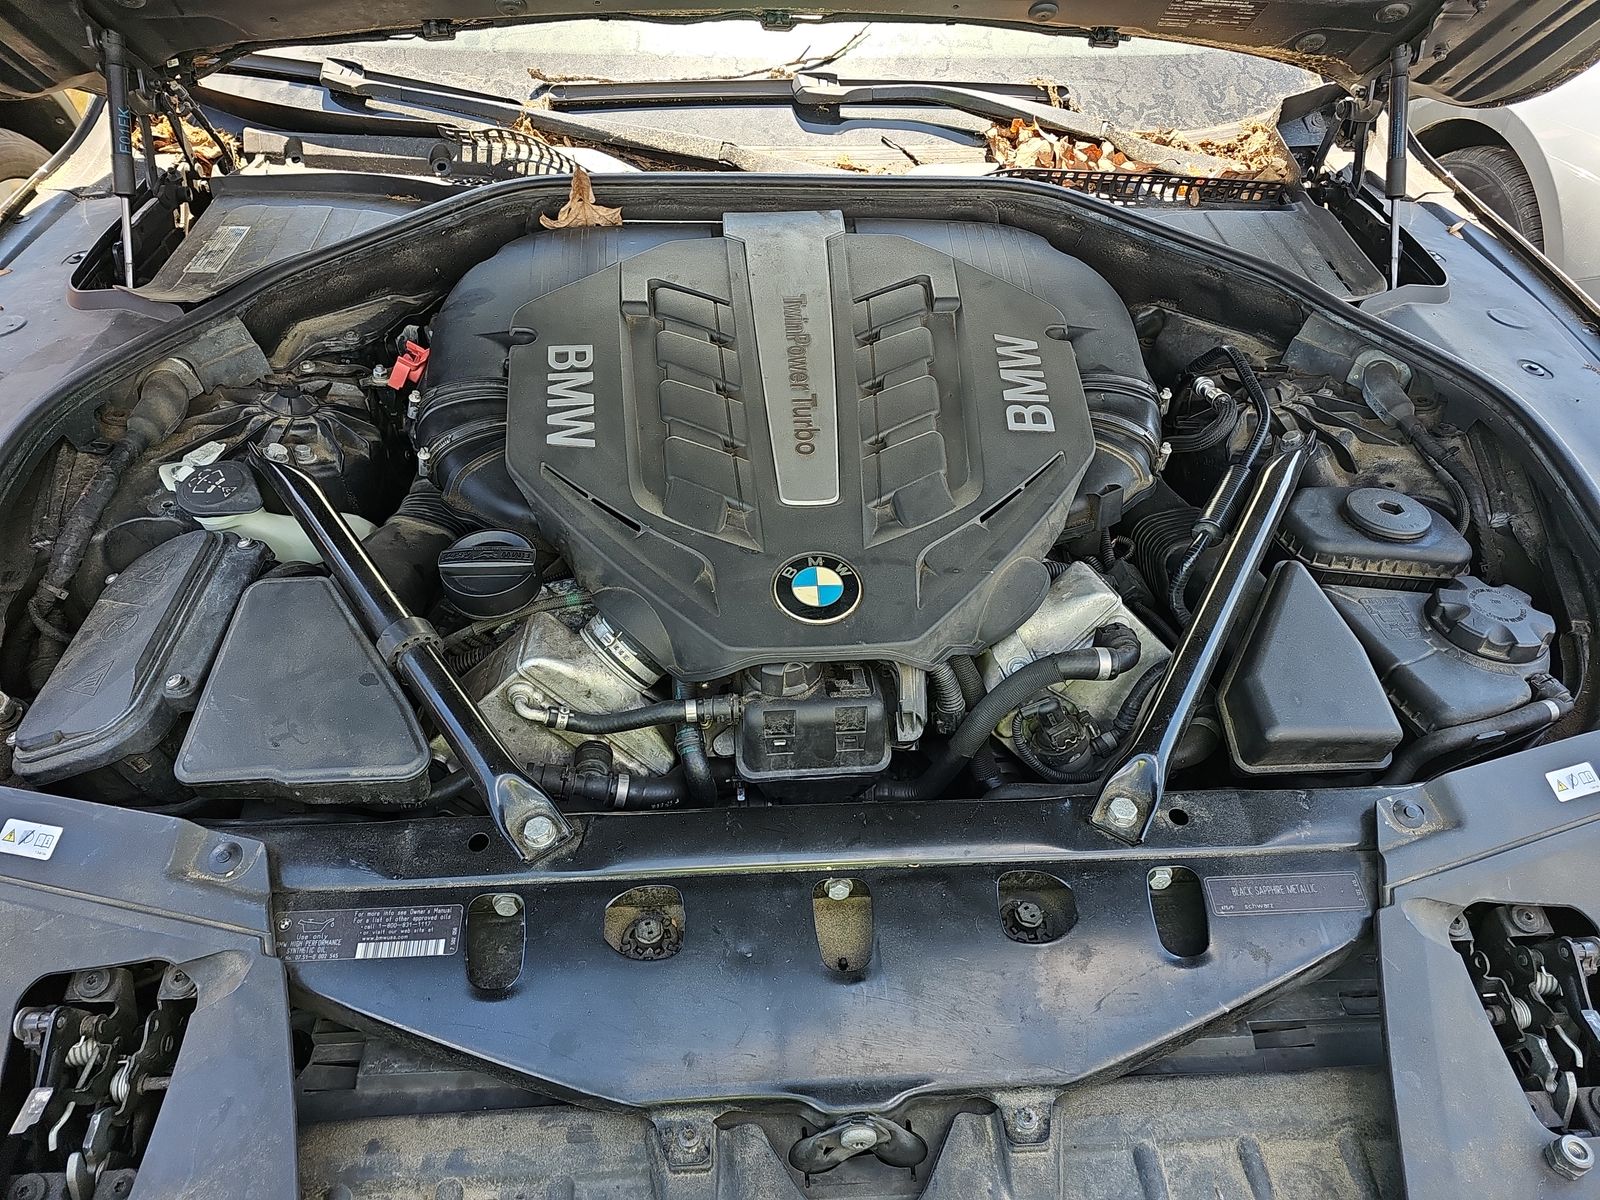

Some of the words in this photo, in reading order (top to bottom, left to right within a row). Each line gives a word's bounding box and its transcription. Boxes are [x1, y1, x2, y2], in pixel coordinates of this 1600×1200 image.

[783, 294, 812, 392] TwinPower
[994, 334, 1056, 432] BMW
[546, 344, 596, 448] BMW
[792, 393, 820, 456] Turbo
[782, 556, 852, 578] BMW
[1230, 886, 1254, 896] BLACK
[1254, 885, 1286, 896] SAPPHIRE
[1286, 884, 1318, 894] METALLIC
[379, 920, 432, 928] 1-800-831-1117
[412, 914, 438, 922] approved
[312, 932, 328, 940] only
